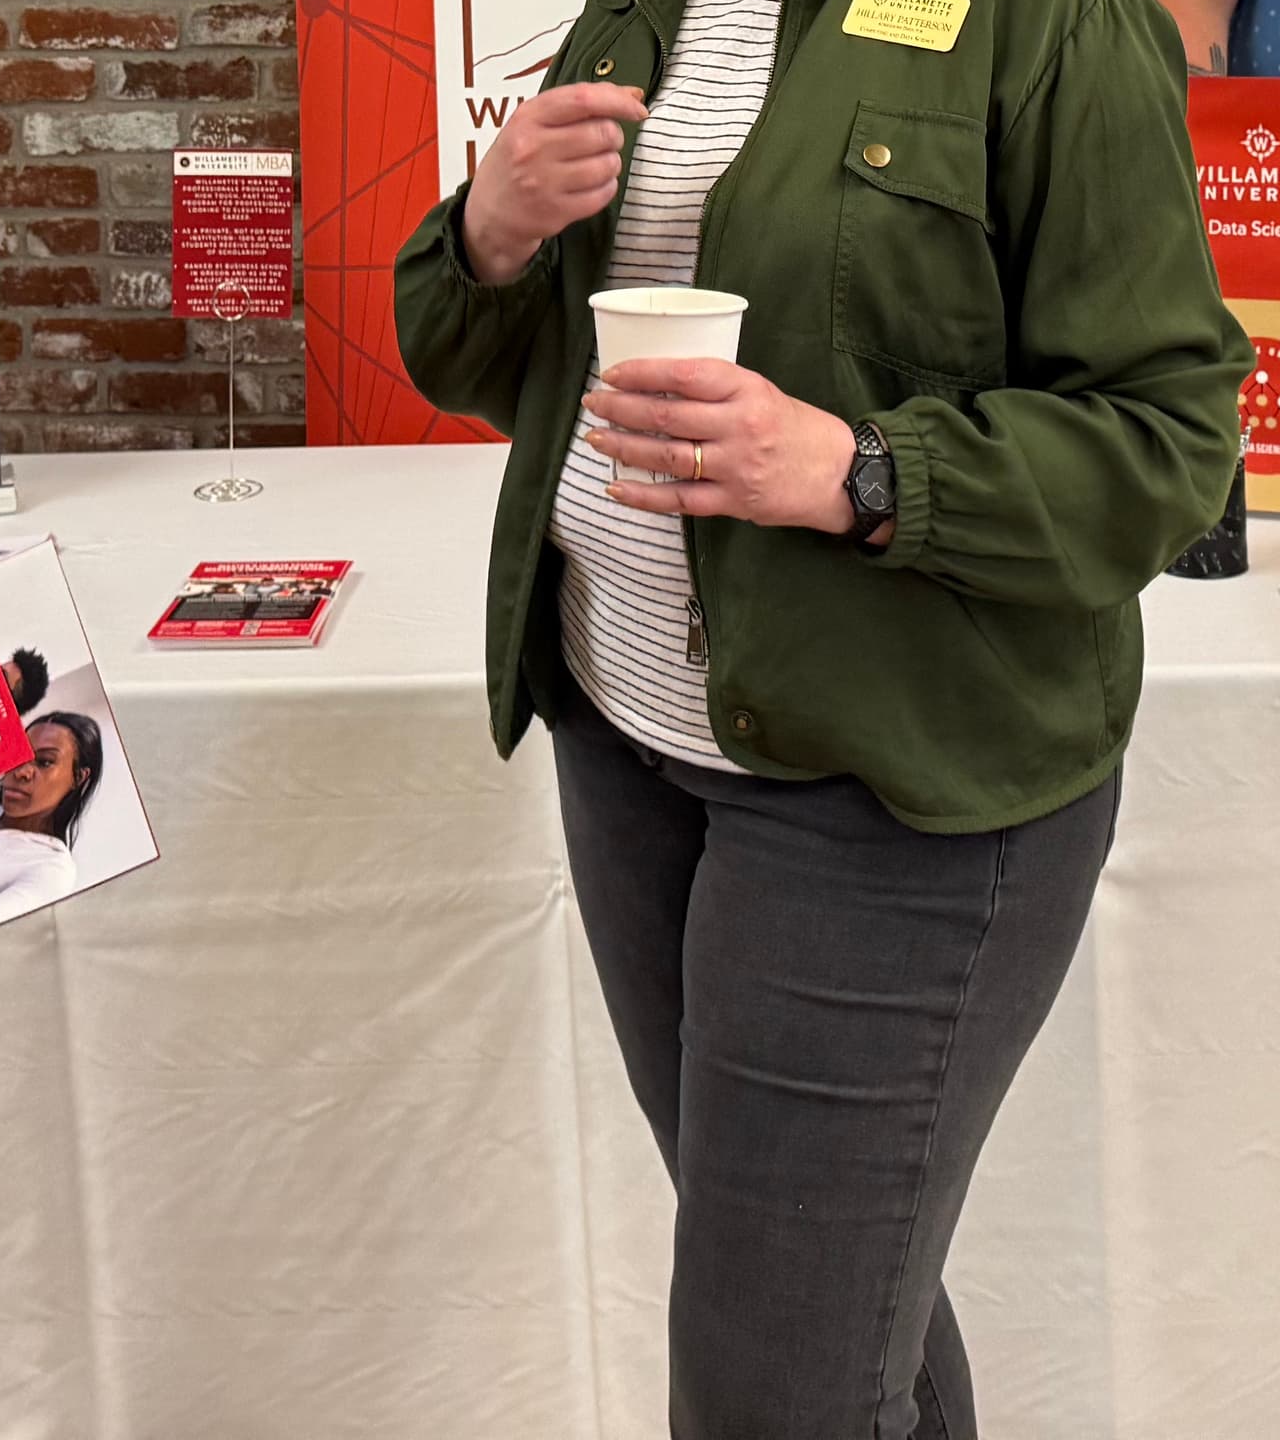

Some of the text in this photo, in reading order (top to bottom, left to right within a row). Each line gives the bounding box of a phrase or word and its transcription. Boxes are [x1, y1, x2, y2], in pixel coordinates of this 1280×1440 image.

[889, 1, 951, 17] UNIVERSITY
[856, 7, 896, 23] HILLARY
[897, 14, 953, 33] PATTERSON
[256, 156, 290, 170] MBA
[1208, 219, 1247, 236] Data
